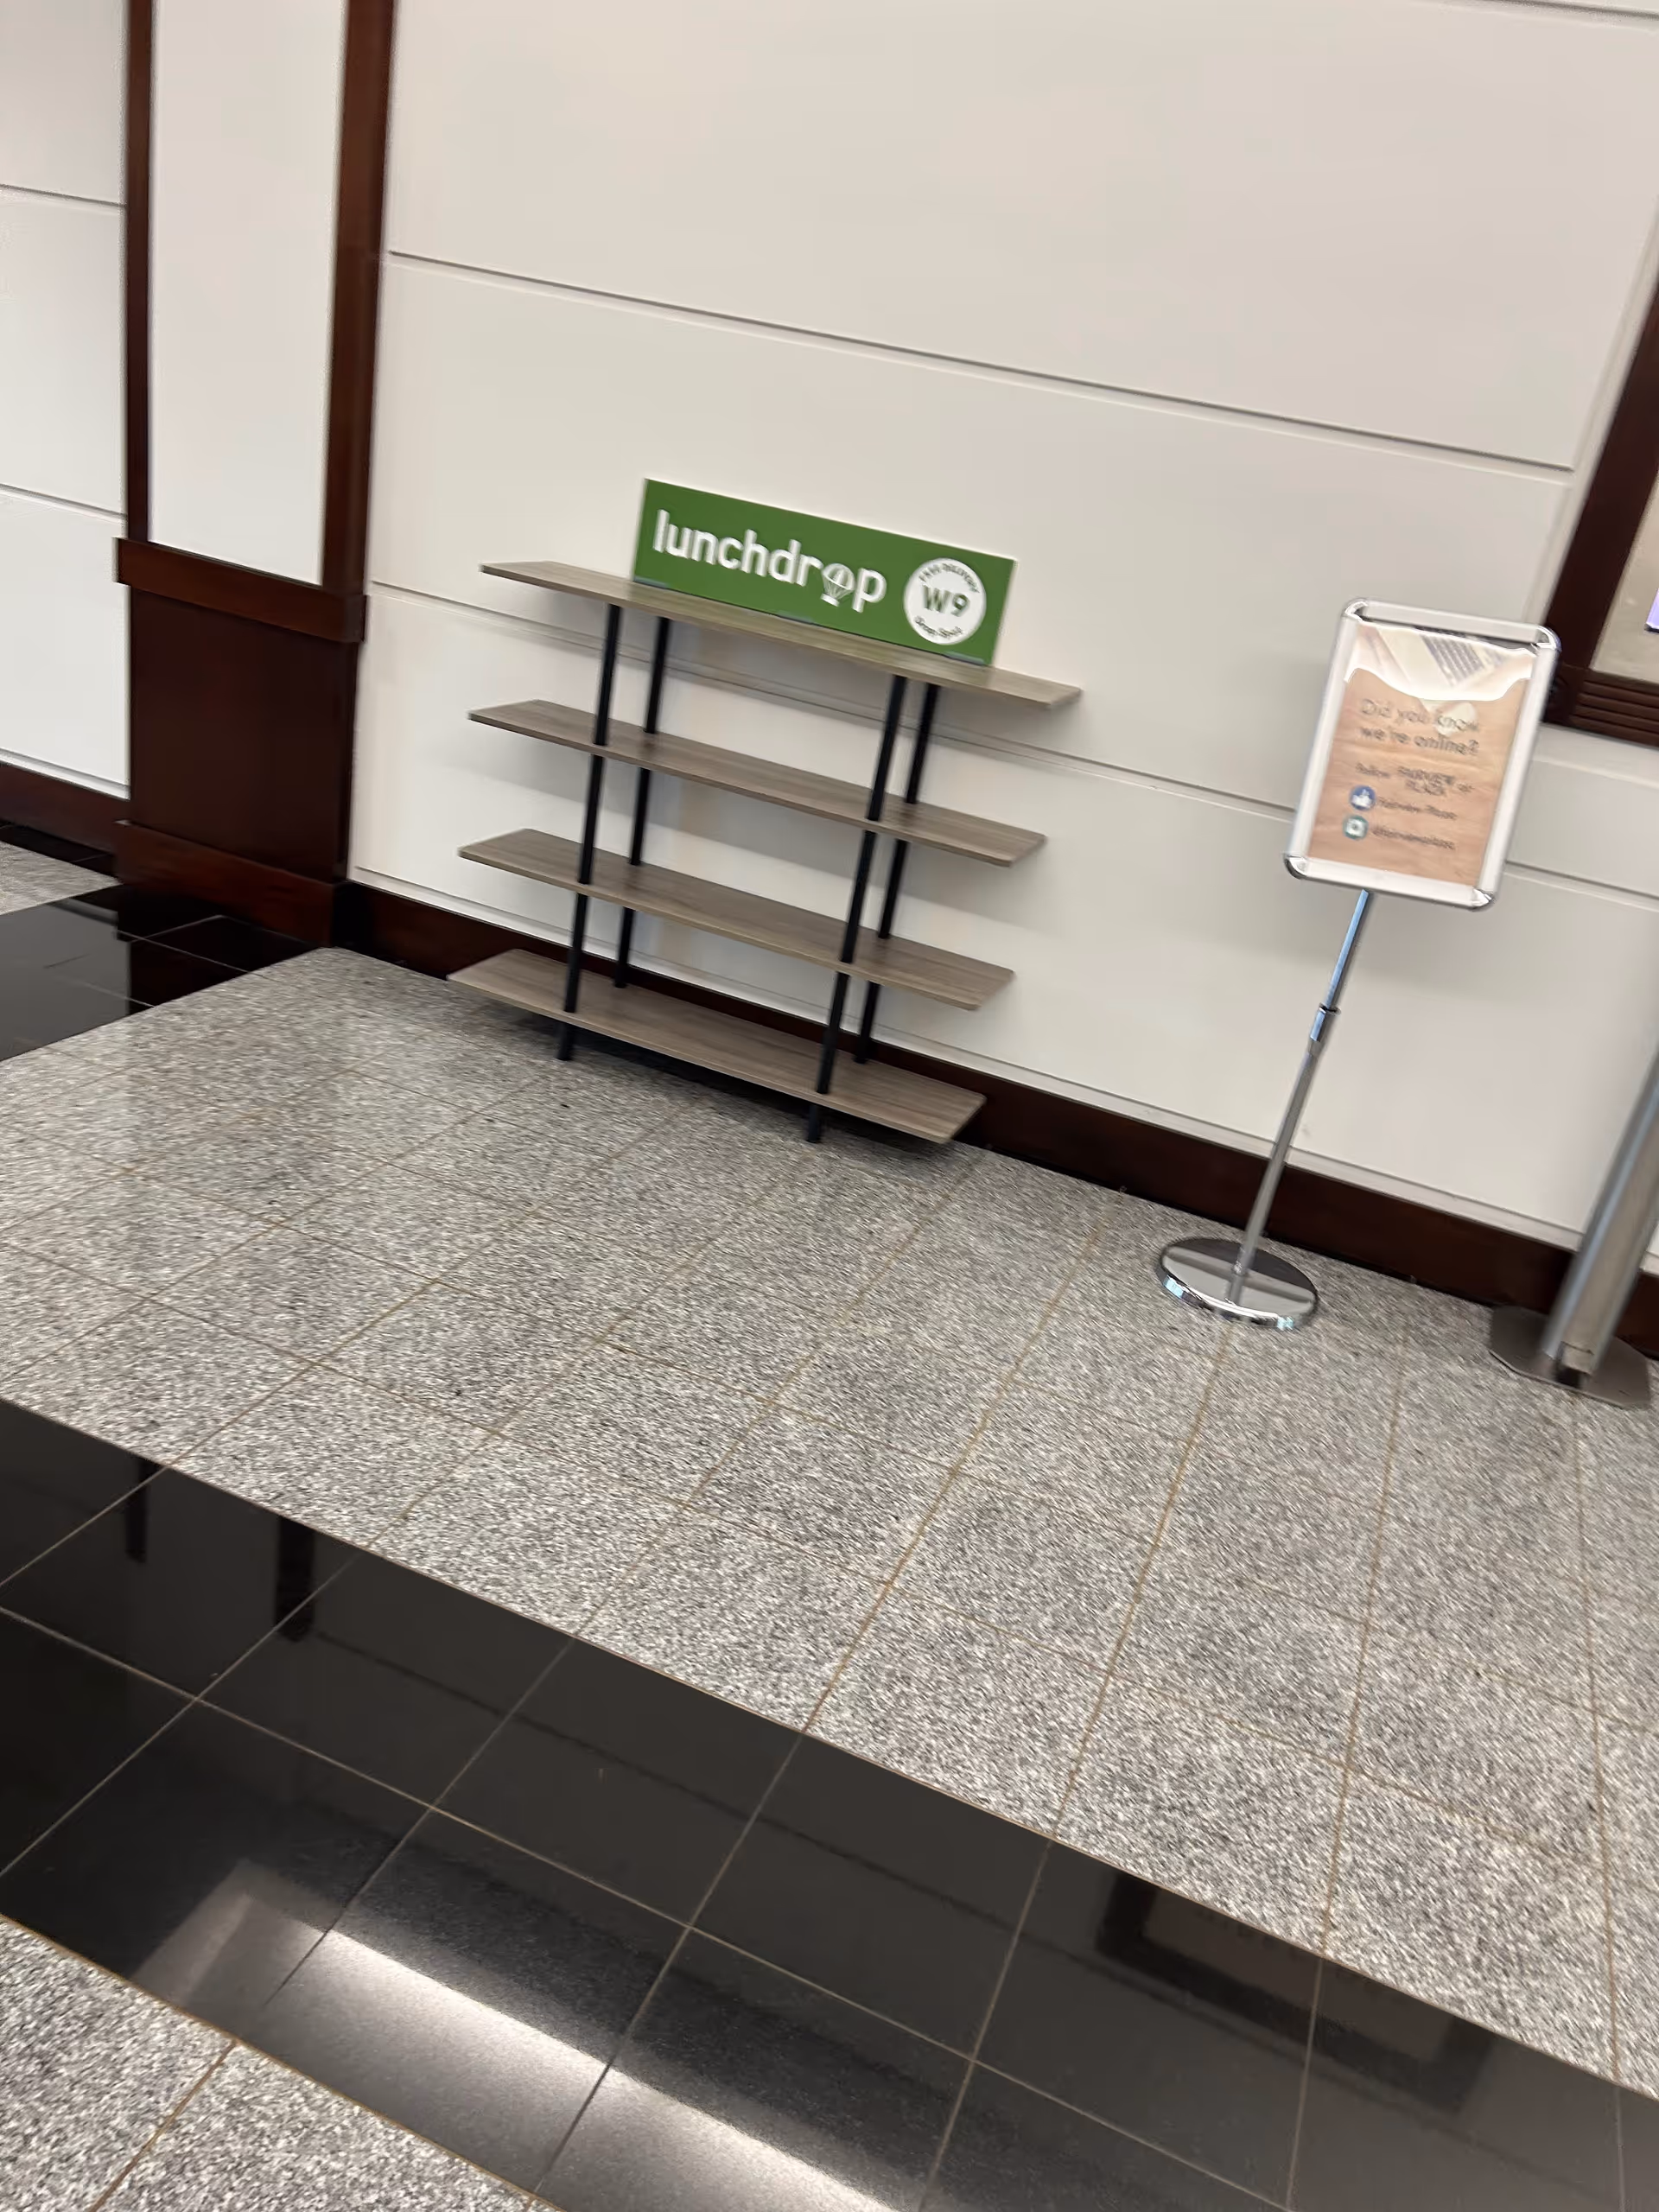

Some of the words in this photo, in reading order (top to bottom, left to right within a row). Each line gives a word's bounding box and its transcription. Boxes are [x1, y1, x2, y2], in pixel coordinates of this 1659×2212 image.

[652, 508, 887, 613] lunchdrop
[922, 584, 971, 617] W9
[1360, 697, 1392, 718] Did
[1395, 707, 1430, 725] you
[1434, 708, 1480, 732] know
[1414, 733, 1480, 755] online?
